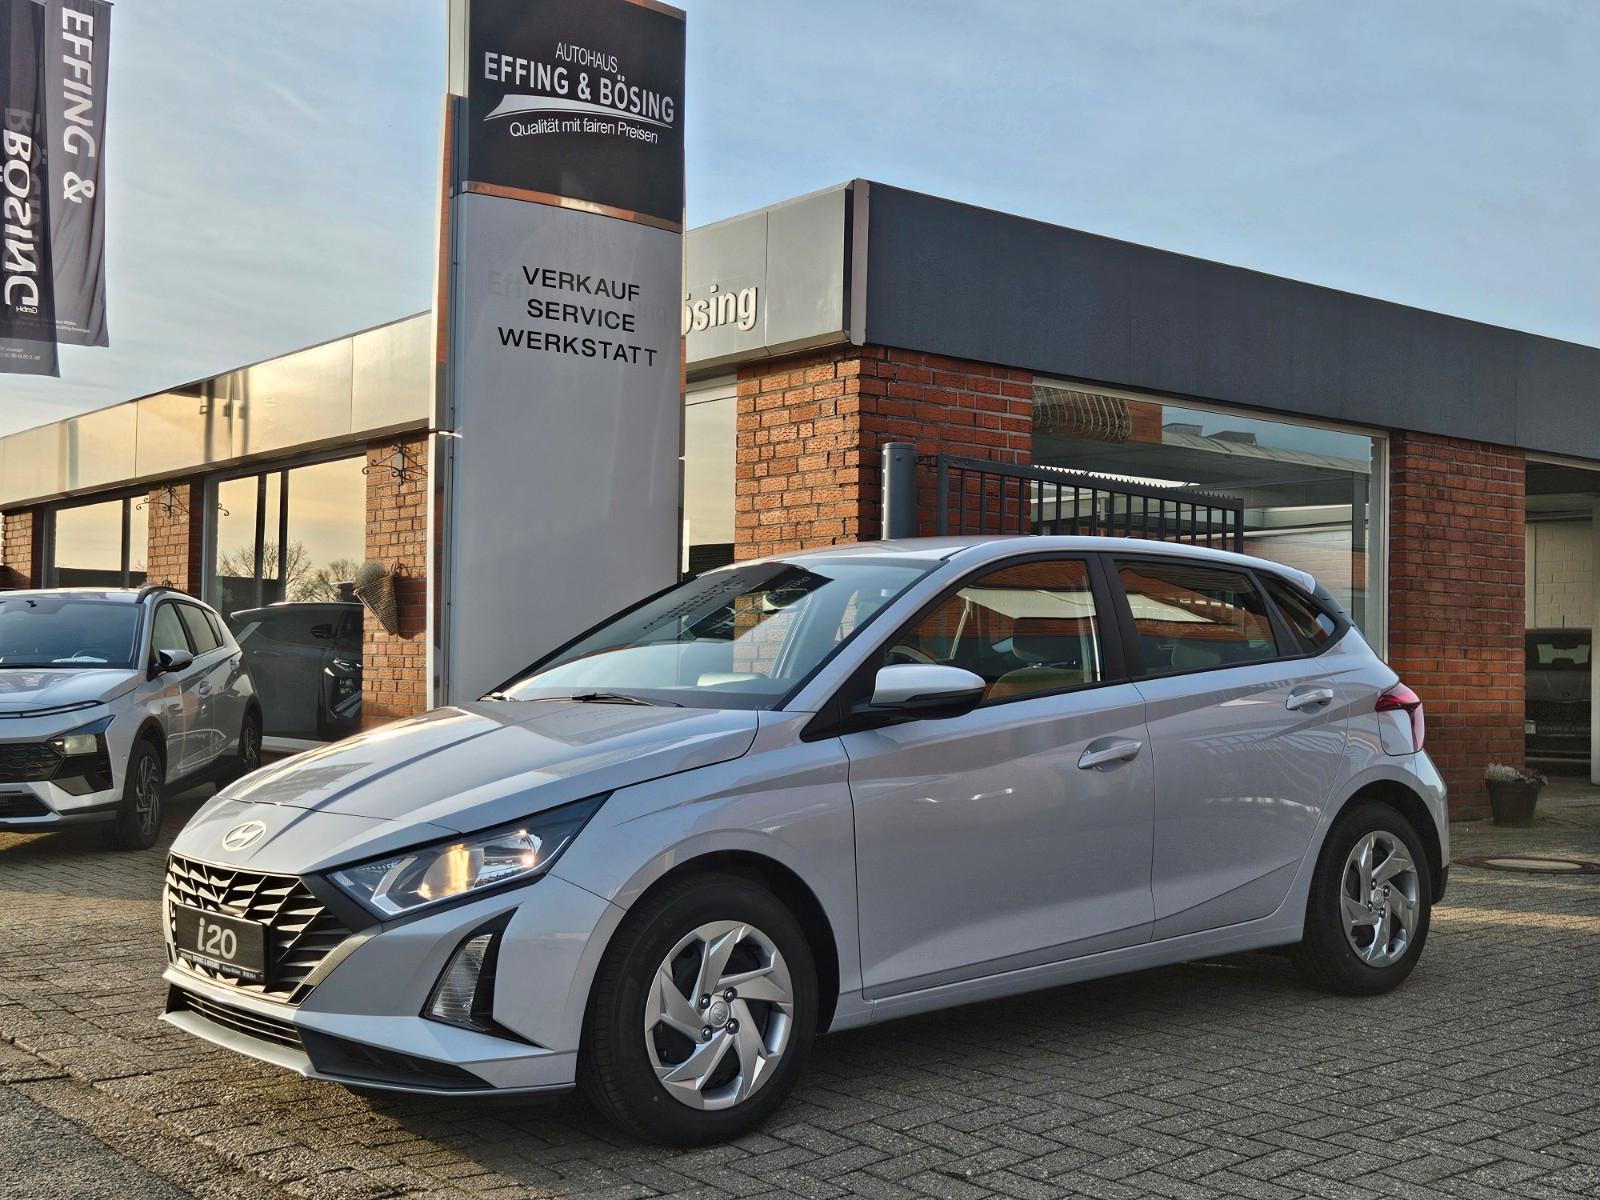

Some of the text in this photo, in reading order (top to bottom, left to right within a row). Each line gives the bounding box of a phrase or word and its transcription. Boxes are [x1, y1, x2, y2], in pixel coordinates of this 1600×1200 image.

[555, 42, 619, 74] AUTOHAUS
[61, 7, 96, 203] EFFING &
[485, 52, 674, 123] EFFING & BÖSING
[510, 117, 658, 144] Qualität mit fairen Preisen
[522, 265, 641, 302] VERKAUF
[527, 299, 636, 333] SERVICE
[498, 327, 658, 367] WERKSTATT
[197, 917, 238, 960] i20
